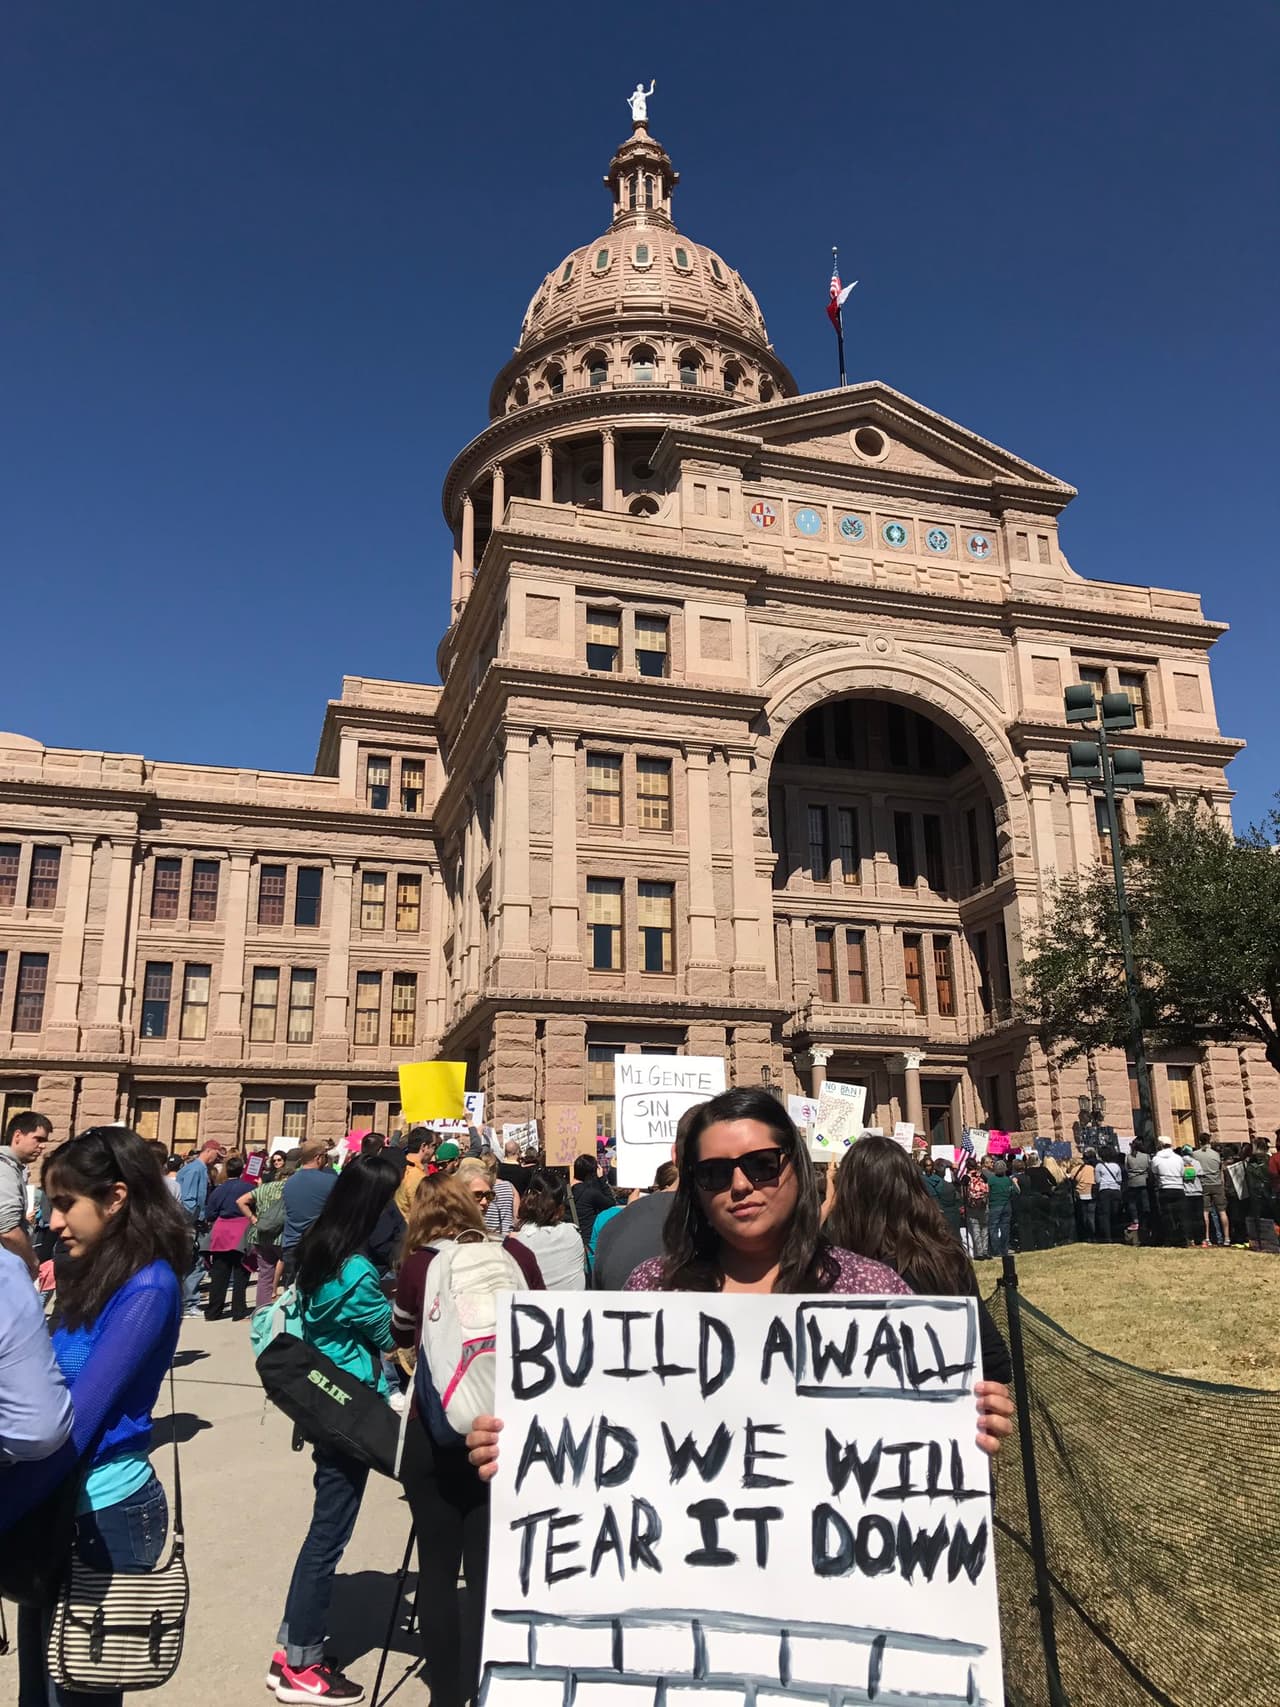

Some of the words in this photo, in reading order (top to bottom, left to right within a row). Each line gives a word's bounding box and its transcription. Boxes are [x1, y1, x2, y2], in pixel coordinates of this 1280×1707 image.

[621, 1064, 643, 1085] MI
[648, 1065, 712, 1090] GENTE
[633, 1099, 669, 1118] SIN
[510, 1298, 736, 1400] BUILD
[761, 1315, 796, 1384] A
[807, 1314, 977, 1392] WALL
[307, 1369, 352, 1405] SLIK
[515, 1414, 640, 1495] AND
[661, 1416, 794, 1489] WE
[825, 1427, 991, 1500] WILL
[510, 1496, 663, 1597] TEAR
[684, 1498, 784, 1570] IT
[811, 1502, 989, 1586] DOWN
